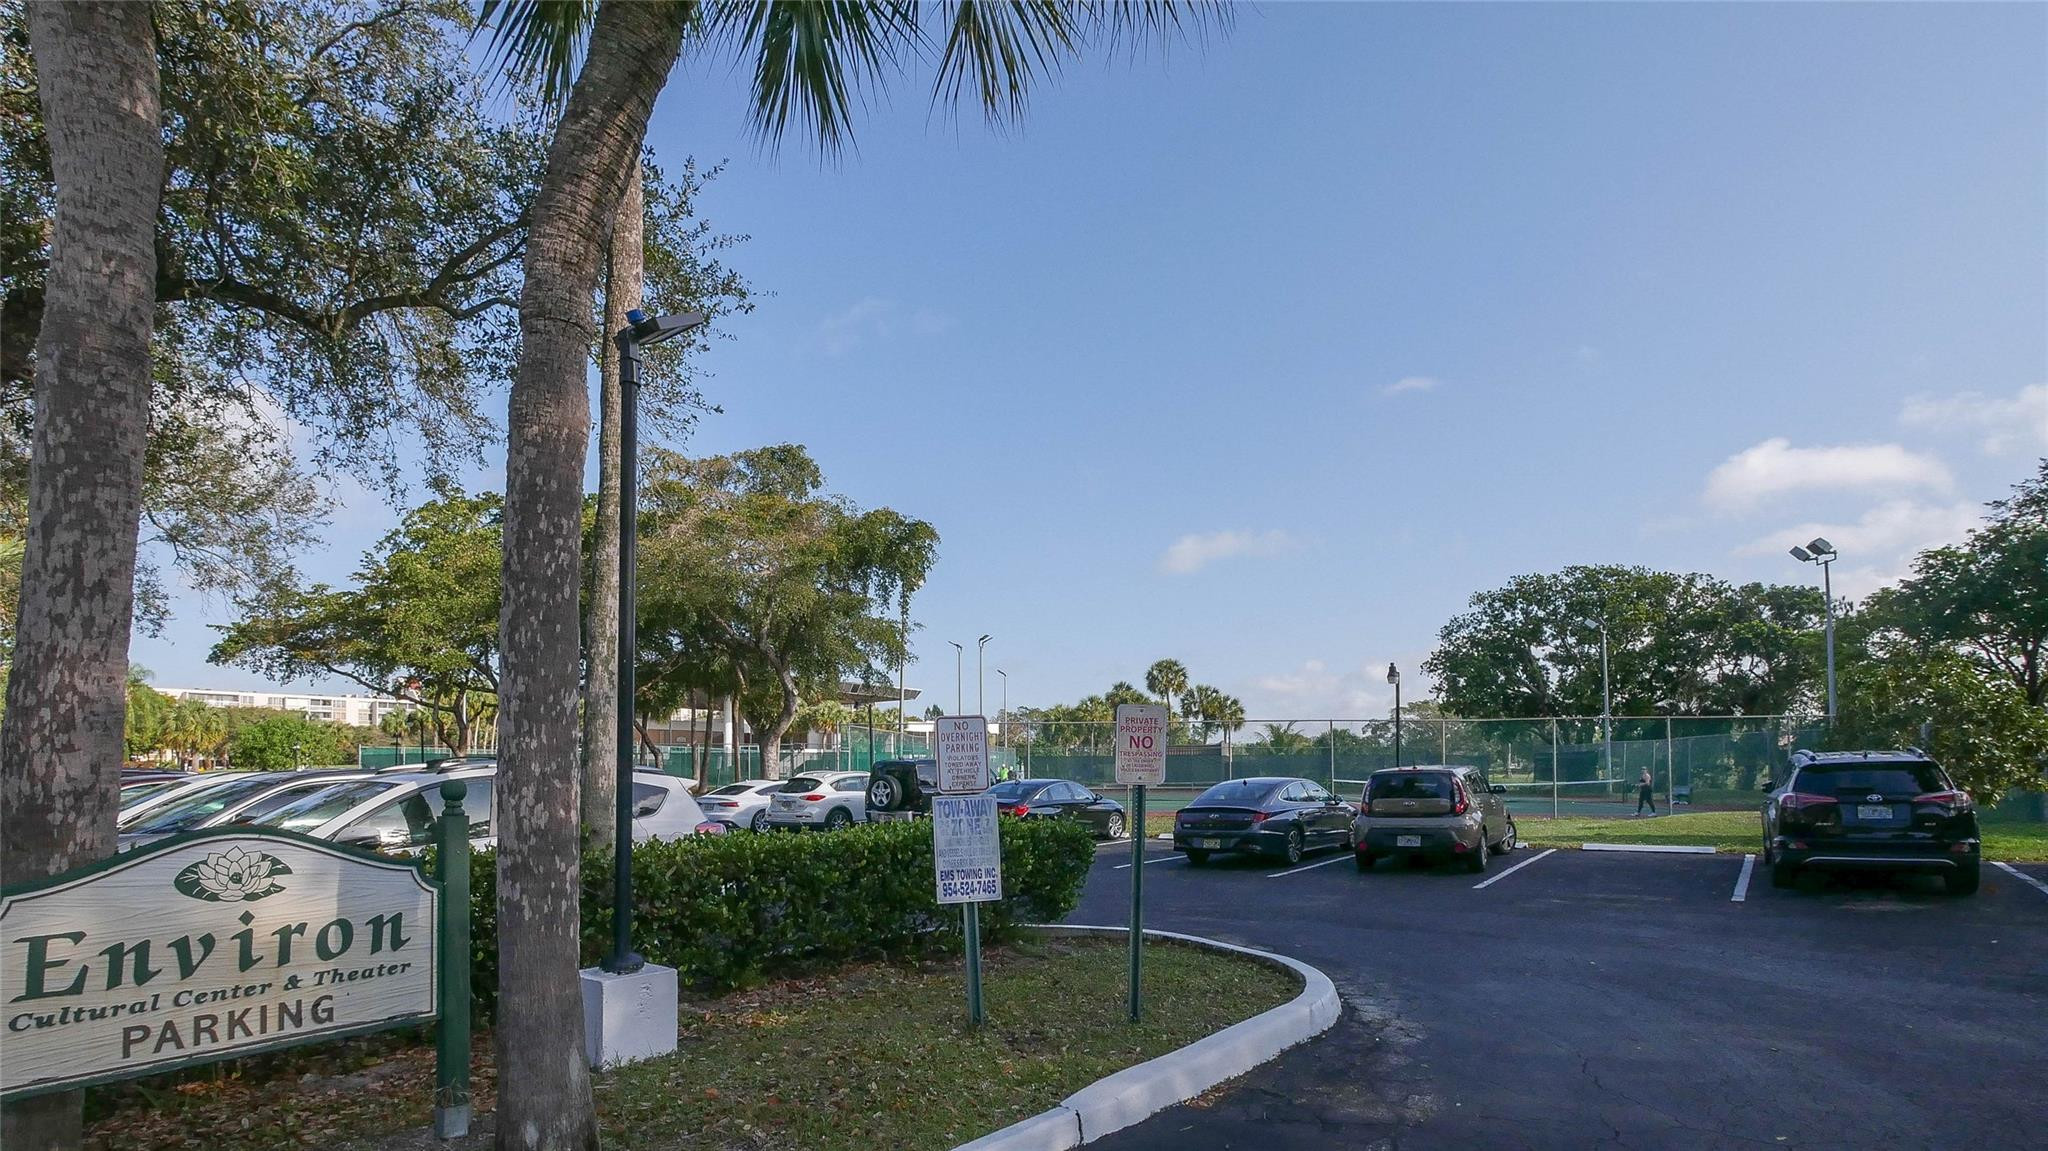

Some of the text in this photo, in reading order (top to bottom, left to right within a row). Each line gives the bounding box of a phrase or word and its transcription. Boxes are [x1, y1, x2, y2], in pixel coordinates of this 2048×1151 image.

[953, 721, 969, 731] NO
[1125, 717, 1159, 725] PRIVATE
[940, 731, 983, 742] OVERNIGHT
[1120, 725, 1163, 734] PROPERTY
[945, 742, 980, 753] PARKING
[1129, 735, 1154, 749] NO
[1120, 750, 1164, 758] TRESPASSING
[936, 799, 993, 819] TOW-AWAY
[951, 817, 981, 836] ZONE
[940, 867, 998, 881] EMS TOWING INC.
[942, 879, 997, 898] 954-524-7465
[8, 910, 411, 1003] Environ
[8, 962, 411, 1032] Cultural Center & Theater
[121, 995, 335, 1059] PARKING
